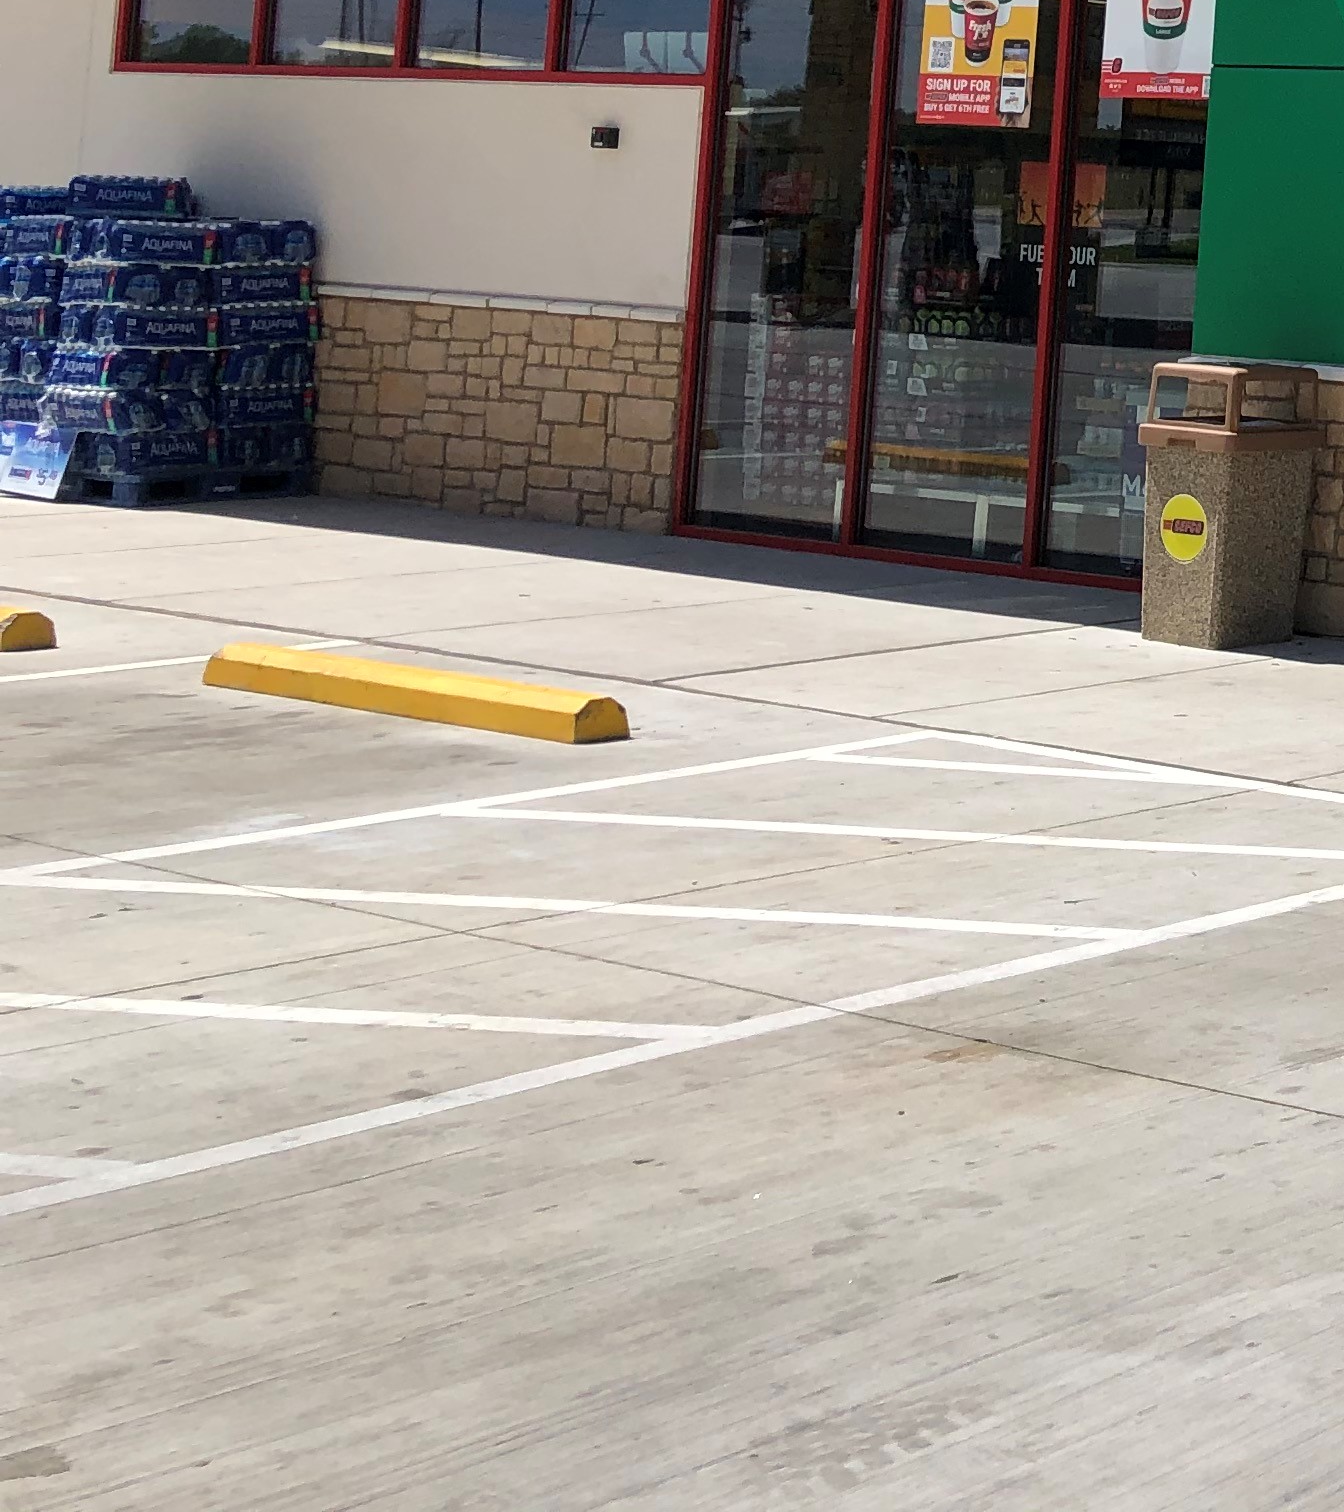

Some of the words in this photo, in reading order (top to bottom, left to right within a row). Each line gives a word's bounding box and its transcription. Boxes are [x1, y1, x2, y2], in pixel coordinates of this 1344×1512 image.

[926, 78, 952, 90] SIGN
[953, 79, 968, 91] UP
[970, 80, 991, 92] FOR
[975, 93, 991, 103] APP
[973, 105, 989, 113] FREE
[1019, 243, 1046, 263] FUE
